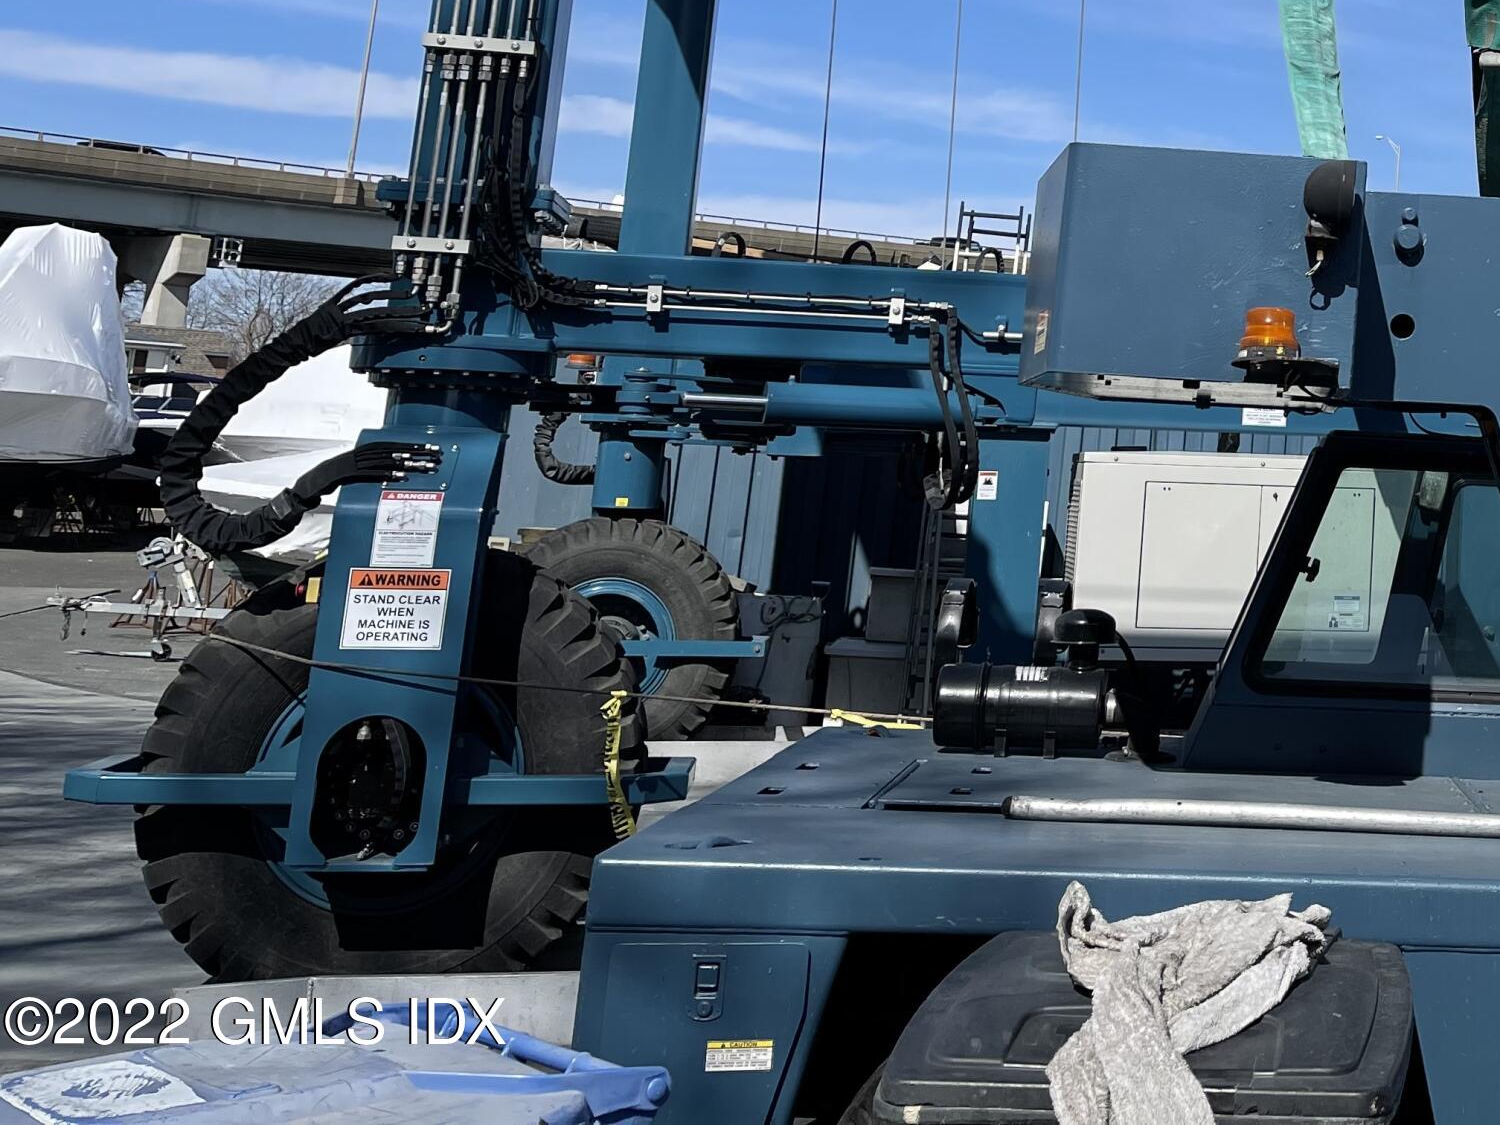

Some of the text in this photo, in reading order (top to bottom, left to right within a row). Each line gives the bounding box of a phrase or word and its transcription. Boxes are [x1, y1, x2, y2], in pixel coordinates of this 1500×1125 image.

[375, 574, 441, 587] WARNING
[353, 594, 441, 605] STAND CLEAR
[377, 607, 414, 617] WHEN
[357, 619, 430, 629] MACHINE IS
[356, 631, 428, 642] OPERATING
